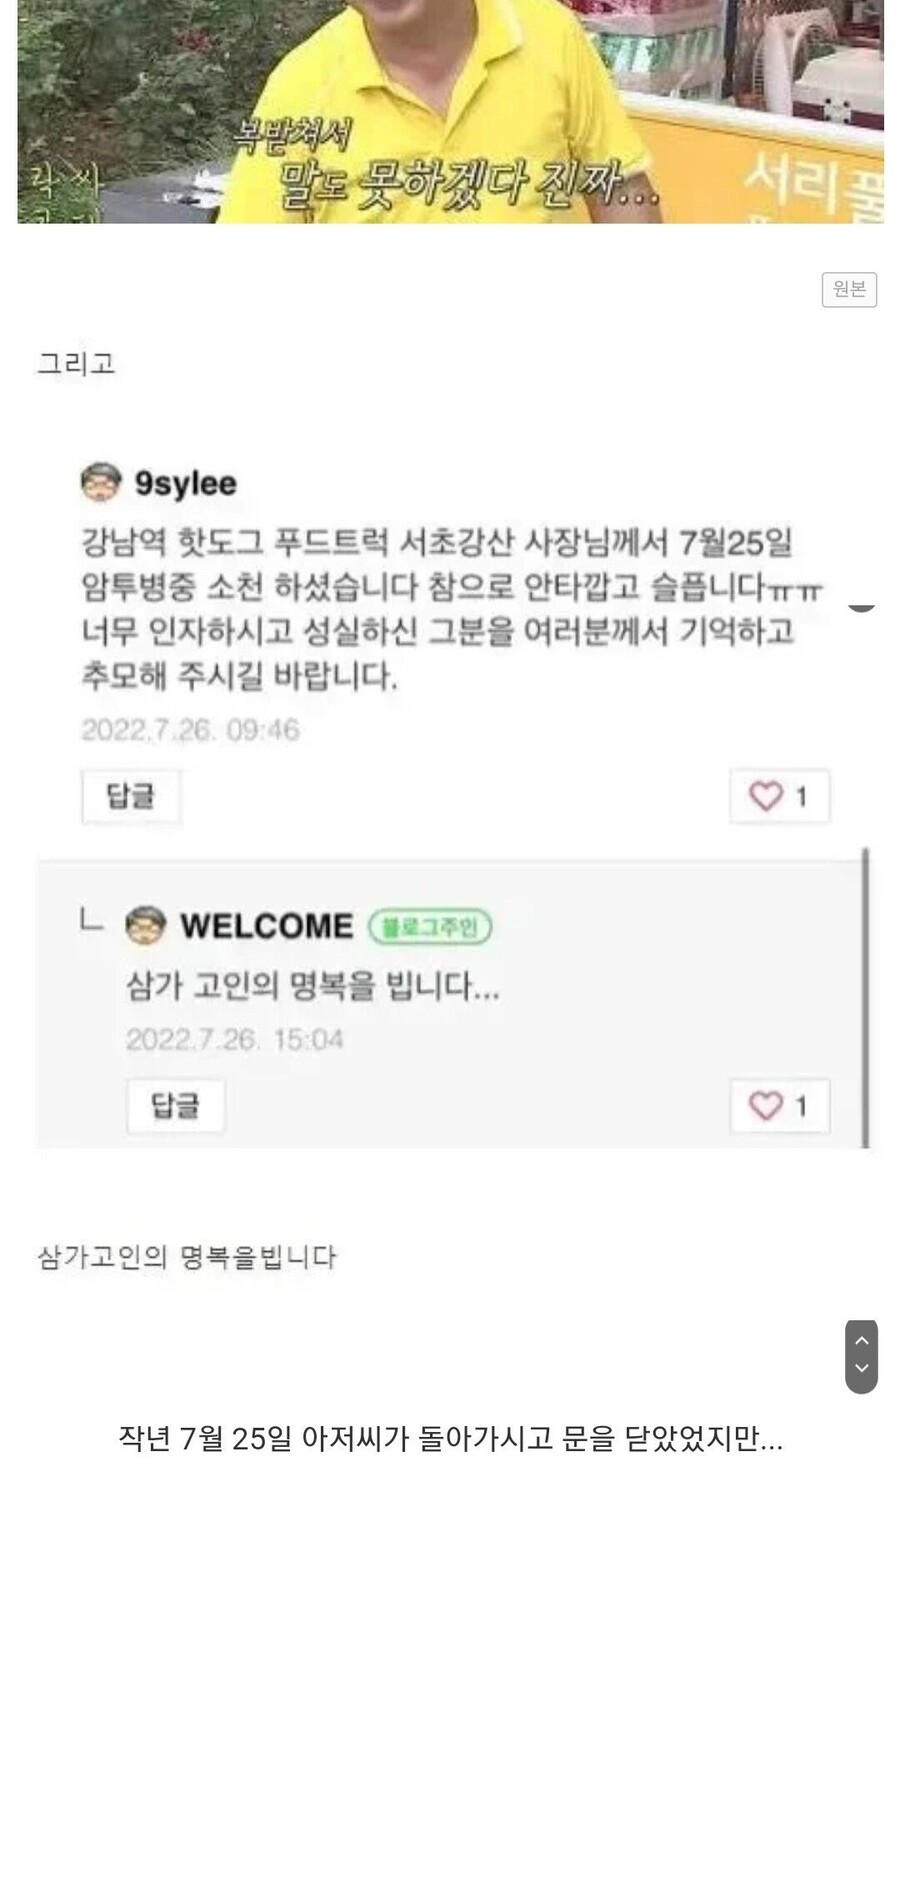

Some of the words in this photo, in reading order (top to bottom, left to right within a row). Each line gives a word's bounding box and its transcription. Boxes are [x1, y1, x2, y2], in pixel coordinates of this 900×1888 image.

[135, 469, 238, 503] 9sylee
[83, 527, 166, 558] 강남역
[178, 527, 264, 558] 핫도그
[275, 527, 388, 558] 푸드트럭
[400, 527, 515, 558] 서초강산
[525, 527, 668, 558] 사장님께서
[680, 527, 791, 559] 7월25일
[227, 717, 300, 742] 09:46
[180, 912, 354, 940] WELCOME
[381, 915, 479, 940] 블로그주인
[126, 970, 183, 1002] 삼가
[194, 970, 278, 1001] 고인의
[290, 970, 376, 1002] 명복을
[387, 970, 499, 1002] 빕니다...
